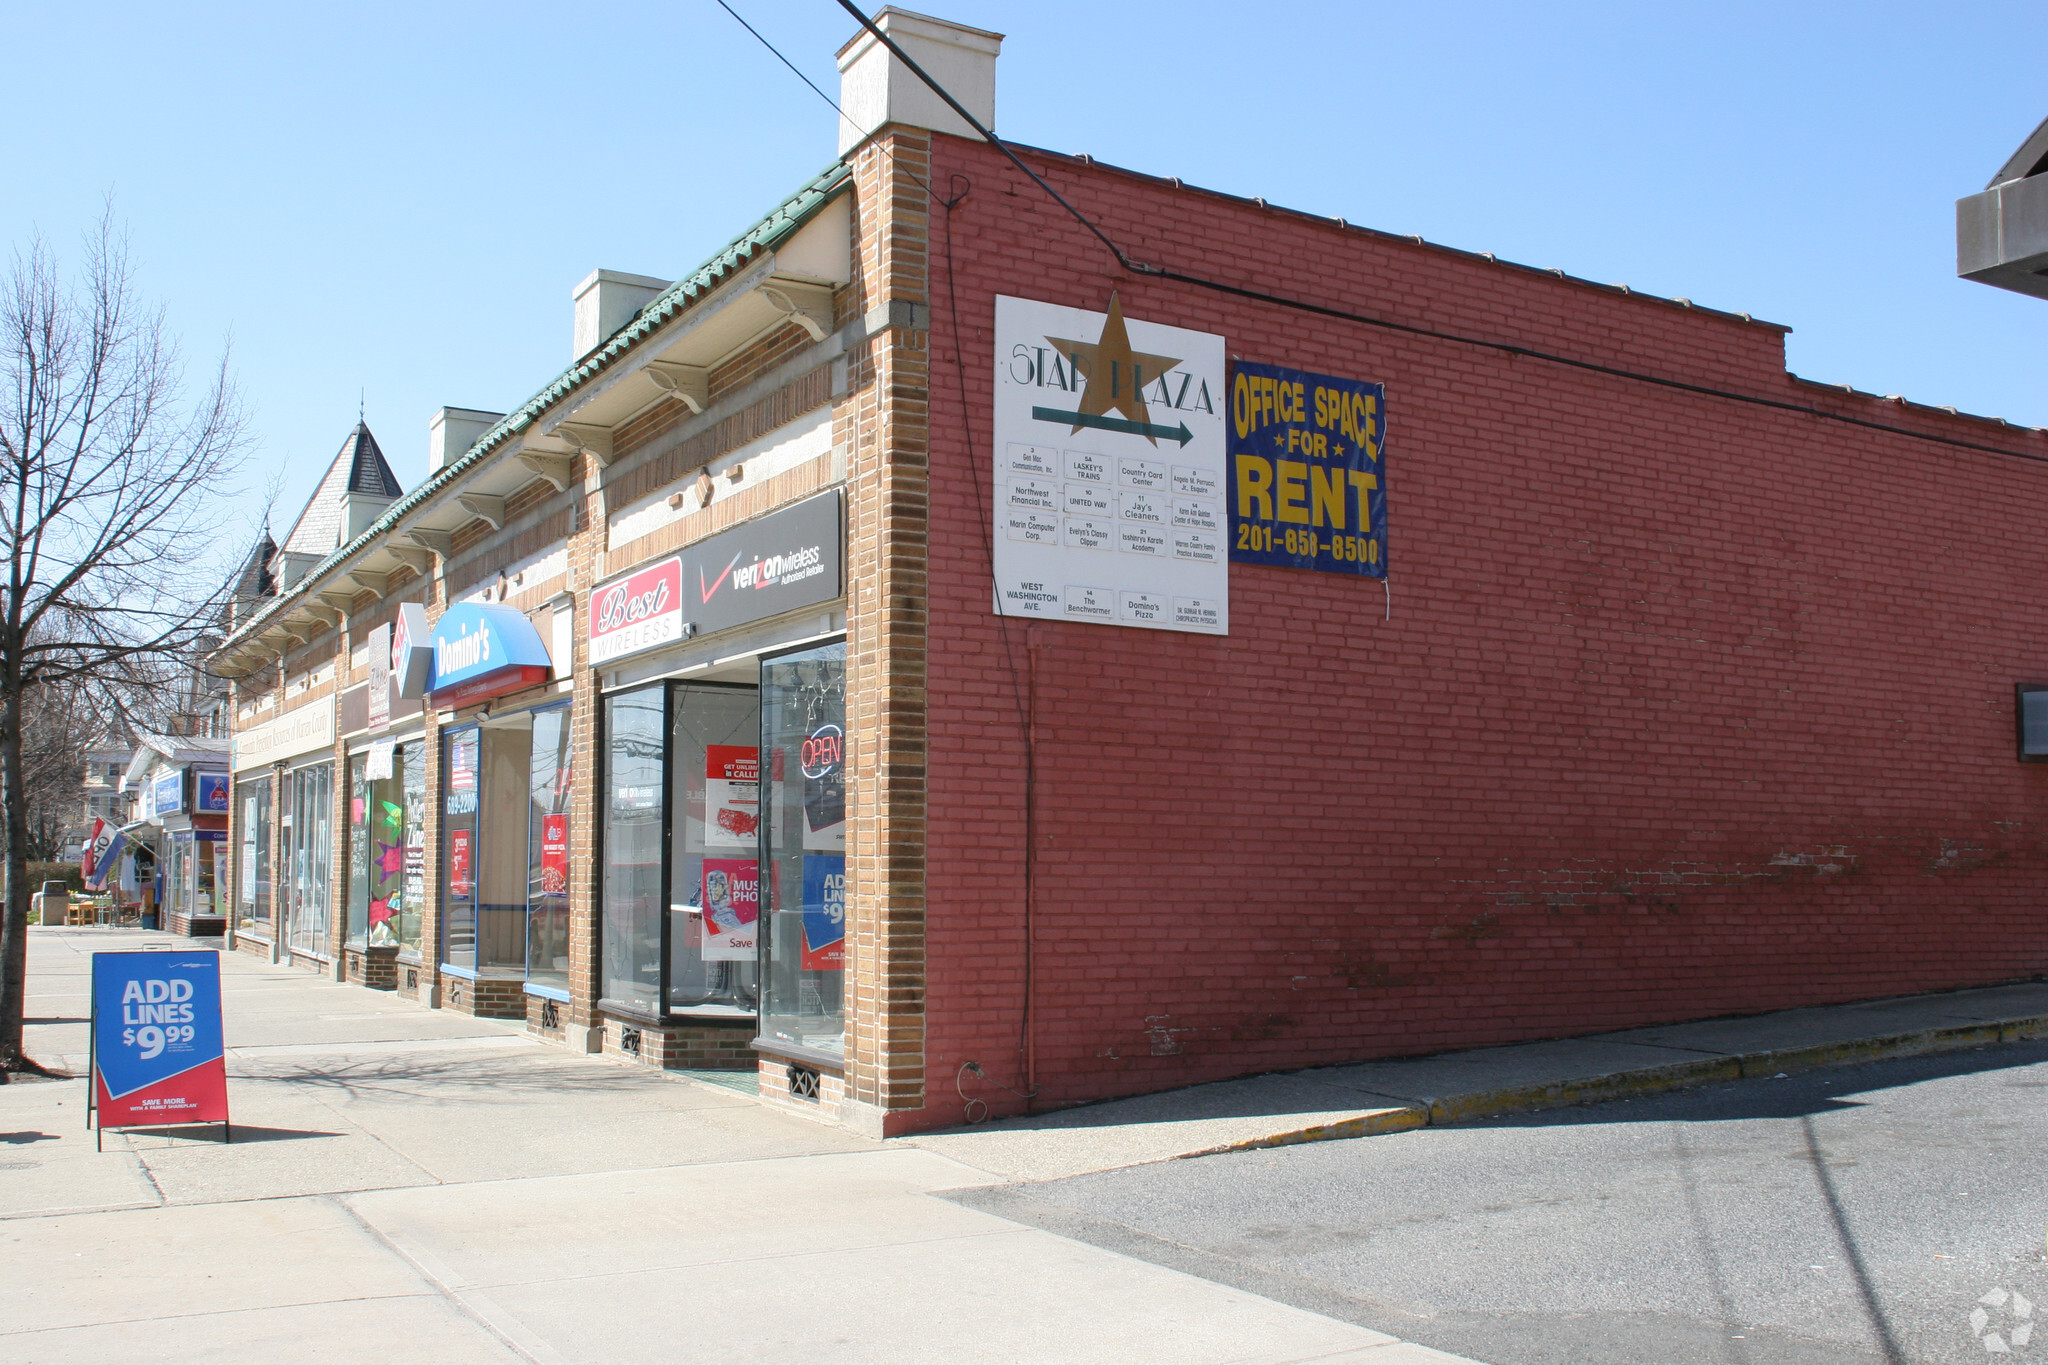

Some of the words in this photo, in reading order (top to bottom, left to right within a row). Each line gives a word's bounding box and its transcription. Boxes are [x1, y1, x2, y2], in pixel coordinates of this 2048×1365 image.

[1010, 343, 1092, 395] STAR
[1111, 360, 1214, 415] PLAZA
[1234, 373, 1306, 439] OFFICE
[1315, 386, 1377, 463] SPACE
[1288, 429, 1328, 458] FOR
[1073, 462, 1103, 472] LASKEY'S
[1077, 472, 1101, 481] TRAINS
[1121, 467, 1146, 477] Country
[1148, 471, 1163, 479] Card
[1132, 478, 1153, 486] Center
[1015, 487, 1049, 497] Northwest
[1235, 454, 1378, 533] RENT
[1011, 496, 1041, 506] Financial
[1042, 499, 1054, 508] Inc.
[1070, 498, 1092, 507] UNITED
[1094, 500, 1107, 509] WAY
[1132, 502, 1152, 512] Jay's
[1125, 510, 1160, 521] Cleaners
[1010, 520, 1027, 528] Marin
[1028, 522, 1055, 532] Computer
[1025, 531, 1040, 540] Corp.
[1069, 527, 1090, 536] Evelyn's
[1091, 529, 1108, 540] Classy
[1080, 538, 1098, 547] Clipper
[1147, 536, 1163, 545] Karate
[1237, 523, 1378, 564] 201-858-8500
[1132, 543, 1155, 553] Academy
[781, 568, 805, 585] Authorized
[806, 564, 824, 578] Retailer
[1020, 582, 1043, 591] WEST
[1006, 590, 1058, 602] WASHINGTON
[1084, 597, 1095, 605] The
[598, 577, 669, 633] Best
[1024, 602, 1041, 611] AVE.
[1067, 604, 1110, 615] Benchwarmer
[1128, 601, 1160, 611] Domino's
[1135, 610, 1154, 619] Pizza
[599, 617, 671, 657] WIRELESS
[438, 618, 490, 677] Domino's
[801, 735, 841, 767] OPEN
[733, 880, 758, 891] MUS
[823, 873, 845, 889] AD
[733, 891, 758, 902] PHO
[823, 889, 845, 902] LIN
[730, 938, 752, 948] Save
[122, 979, 194, 1004] ADD
[123, 1003, 195, 1025] LINES
[163, 1097, 186, 1105] MORE
